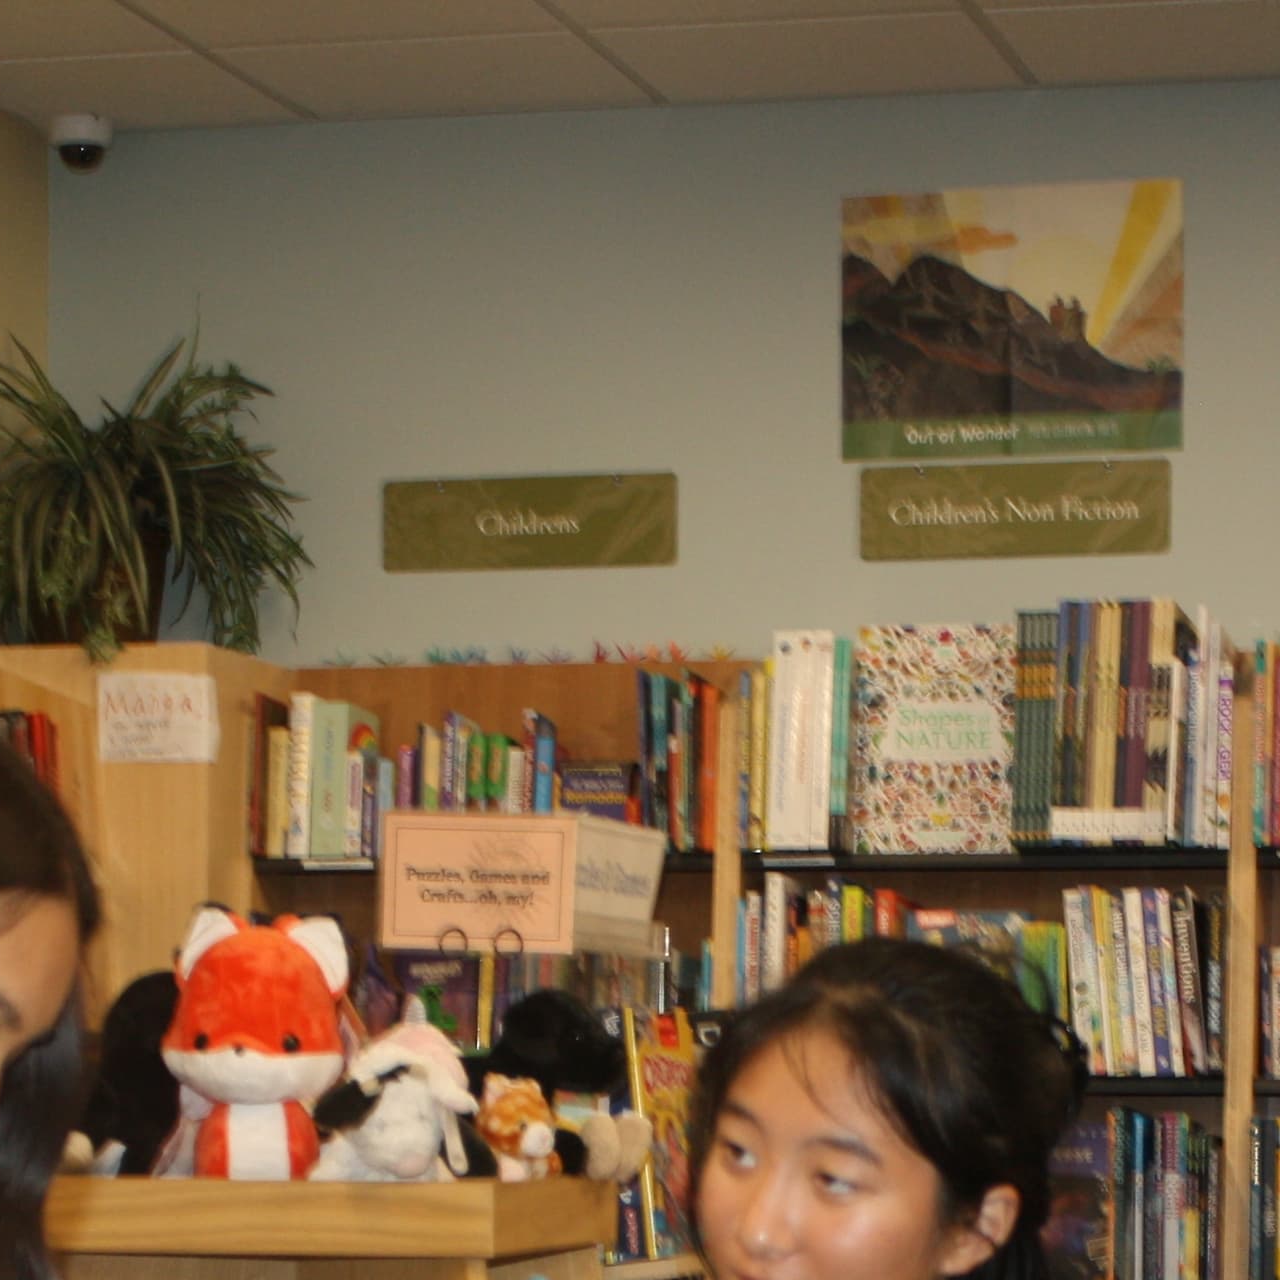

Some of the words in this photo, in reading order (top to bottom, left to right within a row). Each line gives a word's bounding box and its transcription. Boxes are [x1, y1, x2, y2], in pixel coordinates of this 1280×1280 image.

[1005, 495, 1056, 523] Non
[1061, 495, 1140, 522] Fiction
[895, 729, 993, 751] NATURE
[405, 866, 465, 886] Puzzles,
[469, 868, 518, 885] Games
[520, 869, 551, 886] and
[1173, 911, 1197, 1004] Inventions
